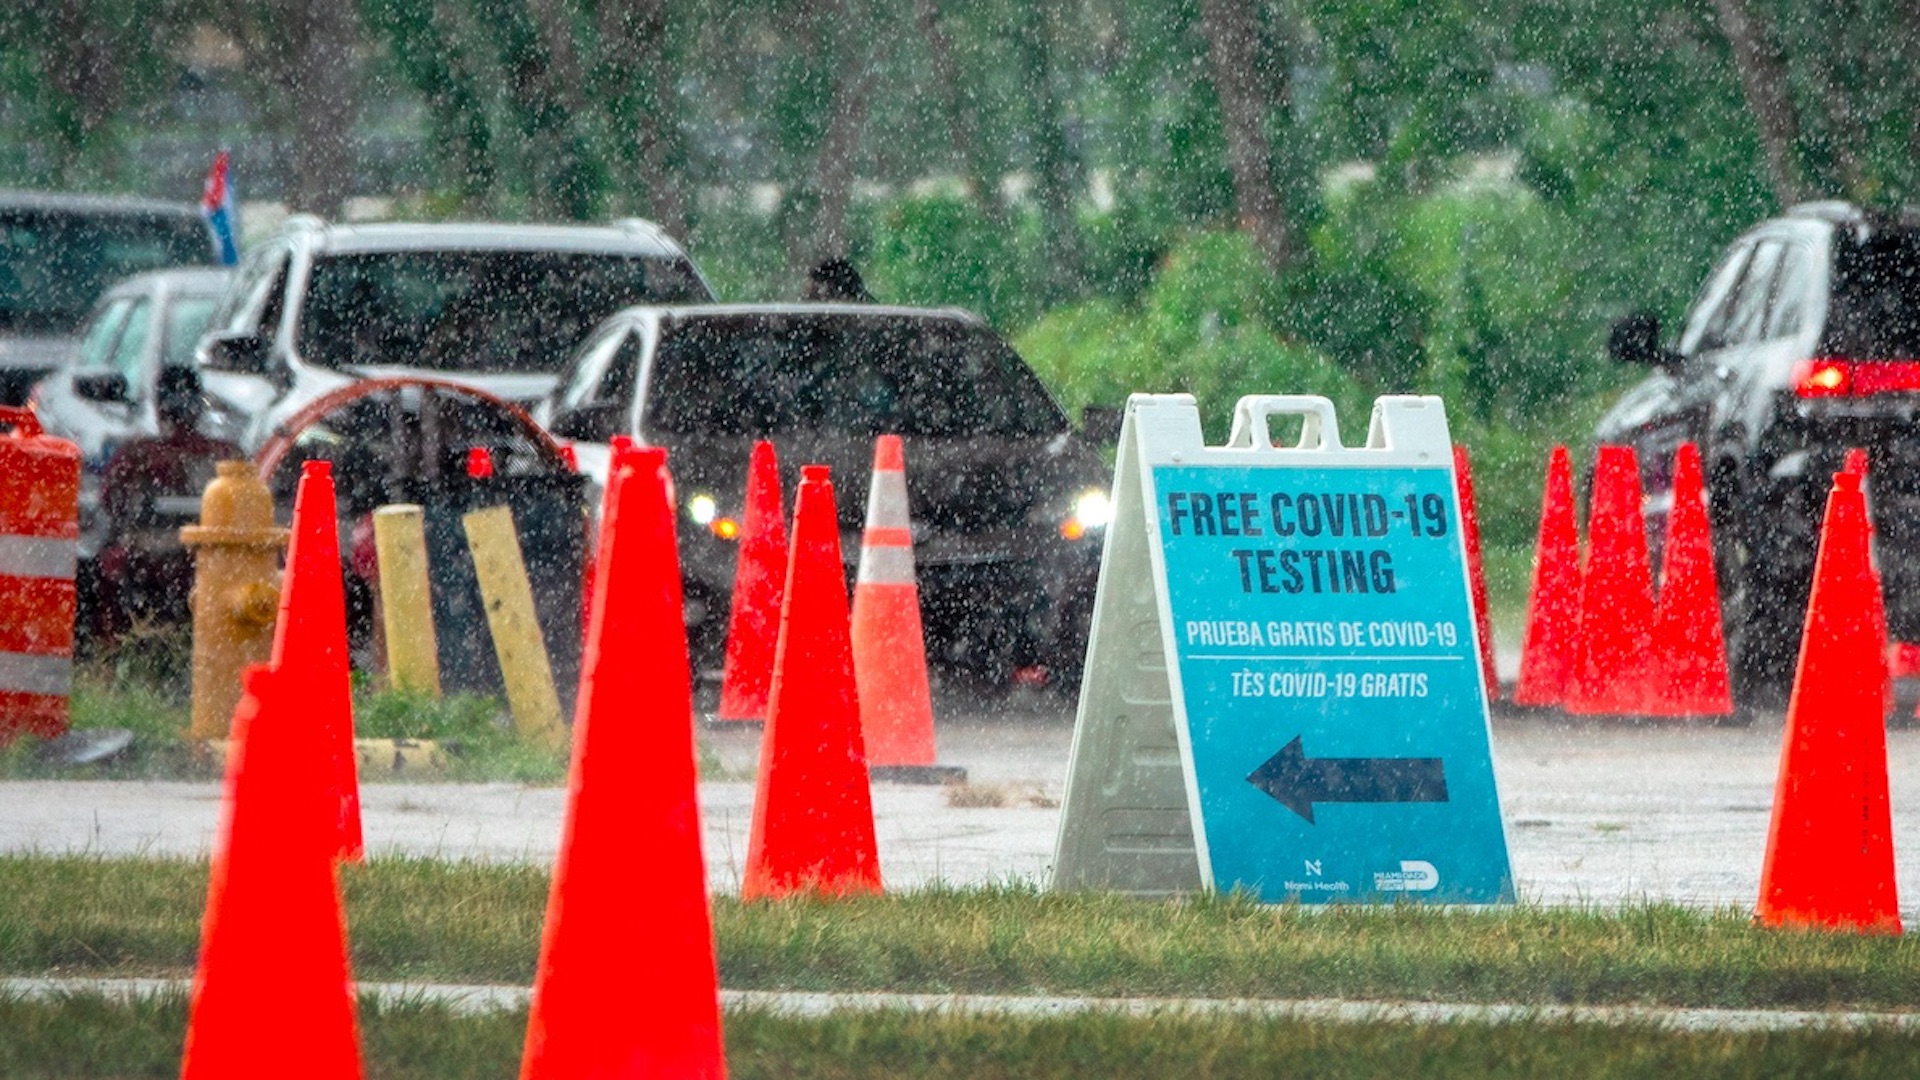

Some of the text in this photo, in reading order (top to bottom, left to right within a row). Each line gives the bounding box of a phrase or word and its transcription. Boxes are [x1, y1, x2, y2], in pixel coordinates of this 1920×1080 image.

[1167, 492, 1447, 537] FREE COVID-19
[1232, 549, 1396, 594] TESTING
[1186, 621, 1457, 647] PRUEBA GRATIS DE COVID-19
[1231, 668, 1428, 698] TÈS COVID-19 GRATIS
[1314, 880, 1349, 892] Health
